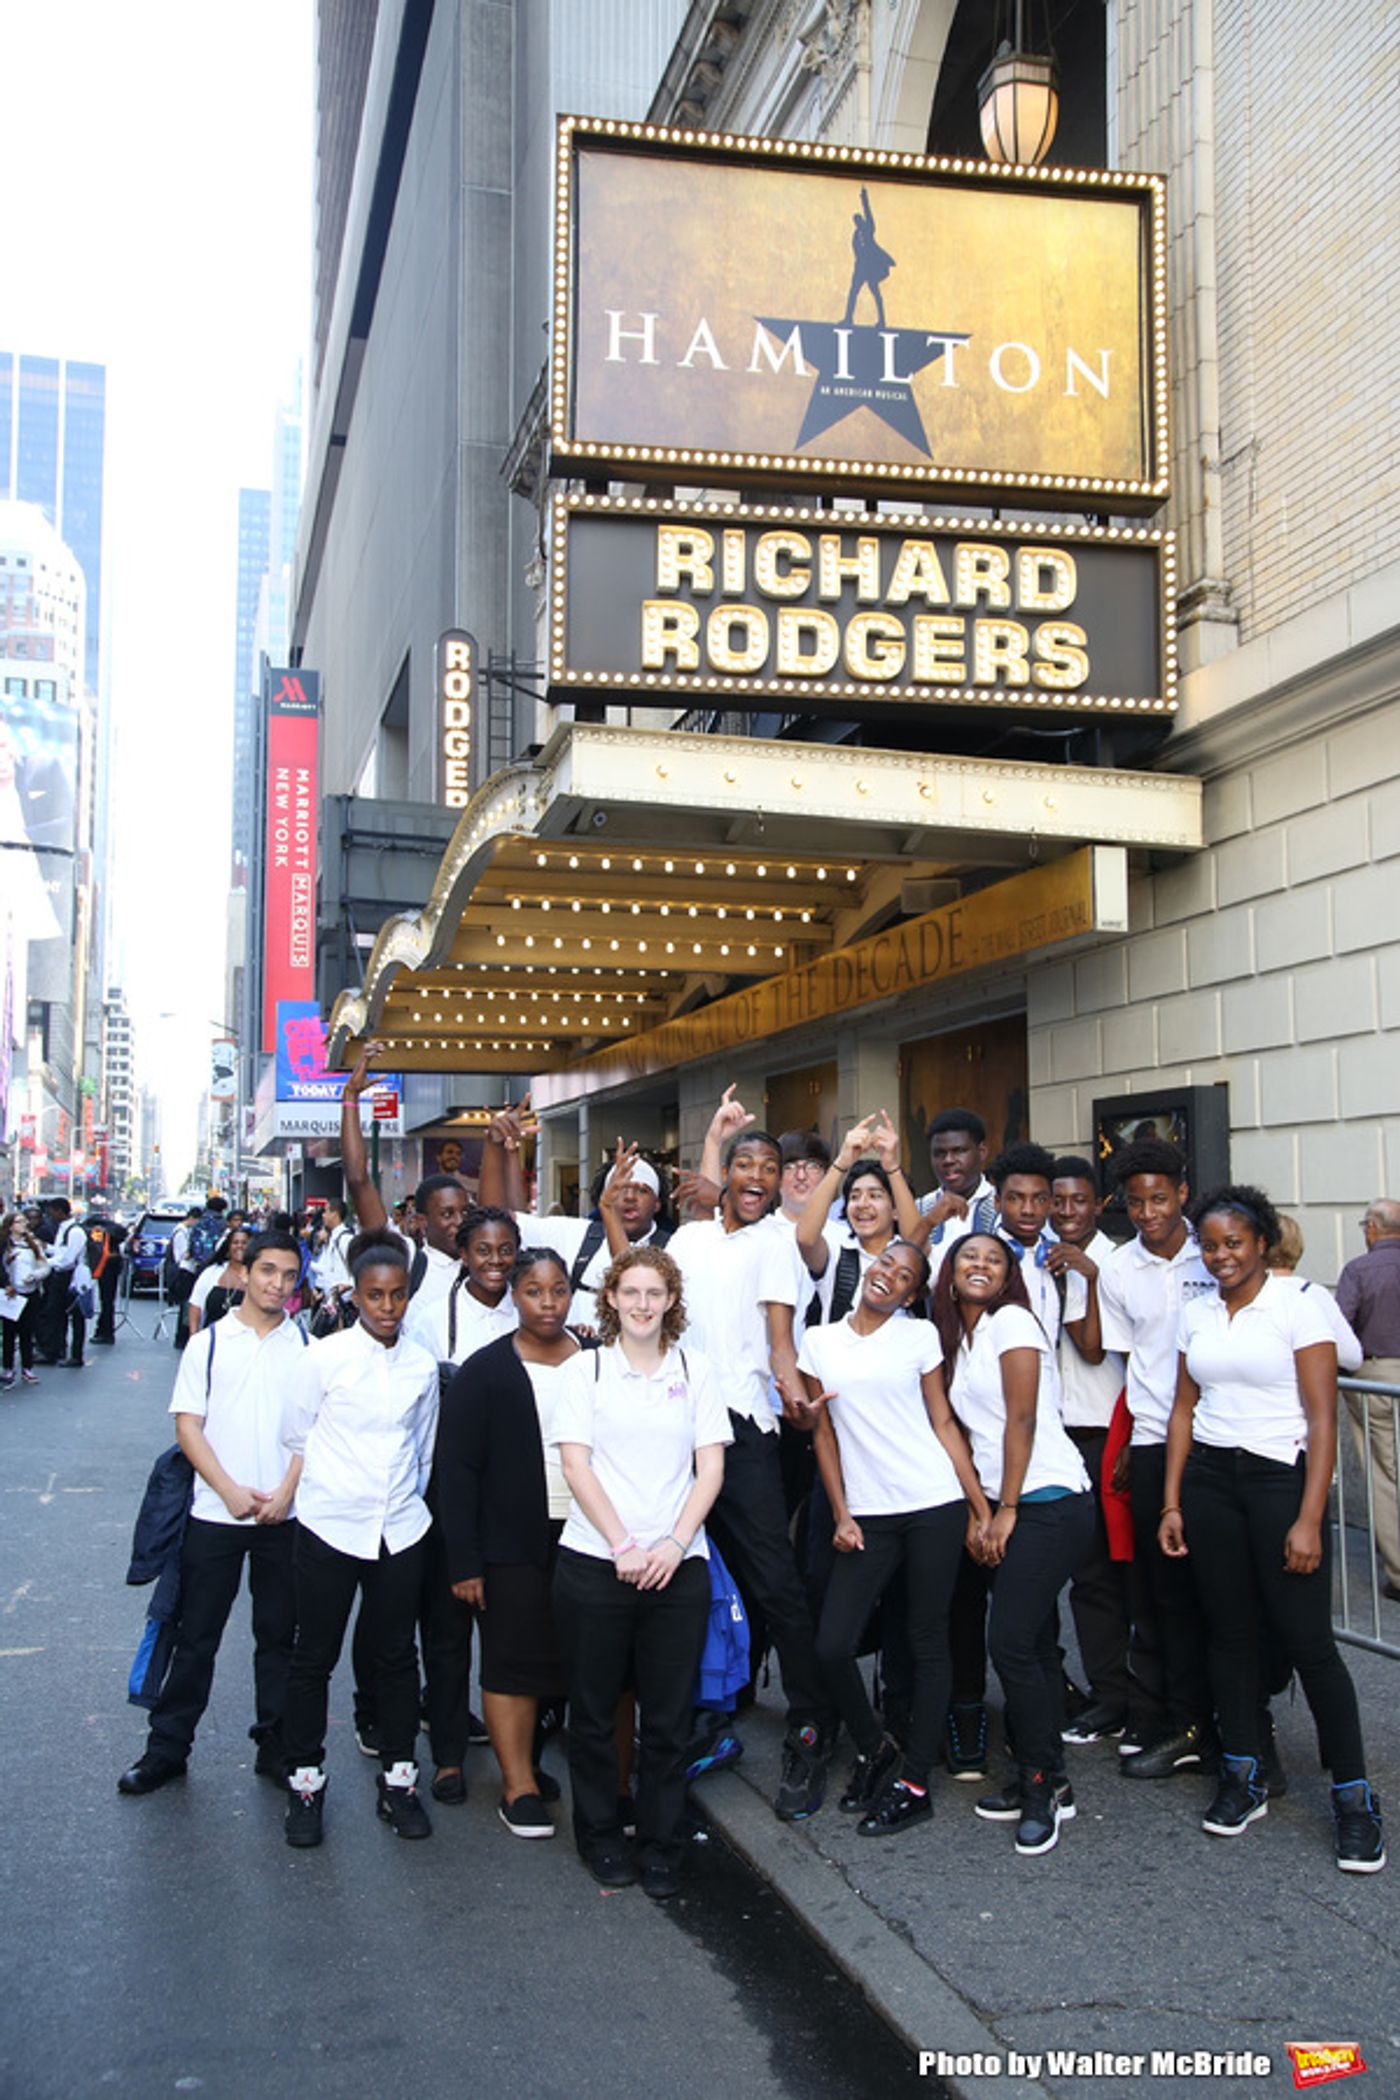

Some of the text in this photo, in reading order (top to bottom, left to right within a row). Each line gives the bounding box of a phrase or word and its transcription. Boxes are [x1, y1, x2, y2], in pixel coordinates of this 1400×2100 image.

[604, 309, 1115, 399] HAMILTON
[656, 524, 1079, 615] RICHARD
[640, 599, 1091, 691] RODGERS
[275, 767, 289, 868] NEW YORK
[294, 768, 309, 966] MARRIOTT MARQUIS
[735, 989, 761, 1039] OF
[770, 965, 817, 1027] THE
[833, 908, 964, 1006] DECADE
[280, 1119, 340, 1135] MARQUIS
[291, 1084, 338, 1097] TODAY
